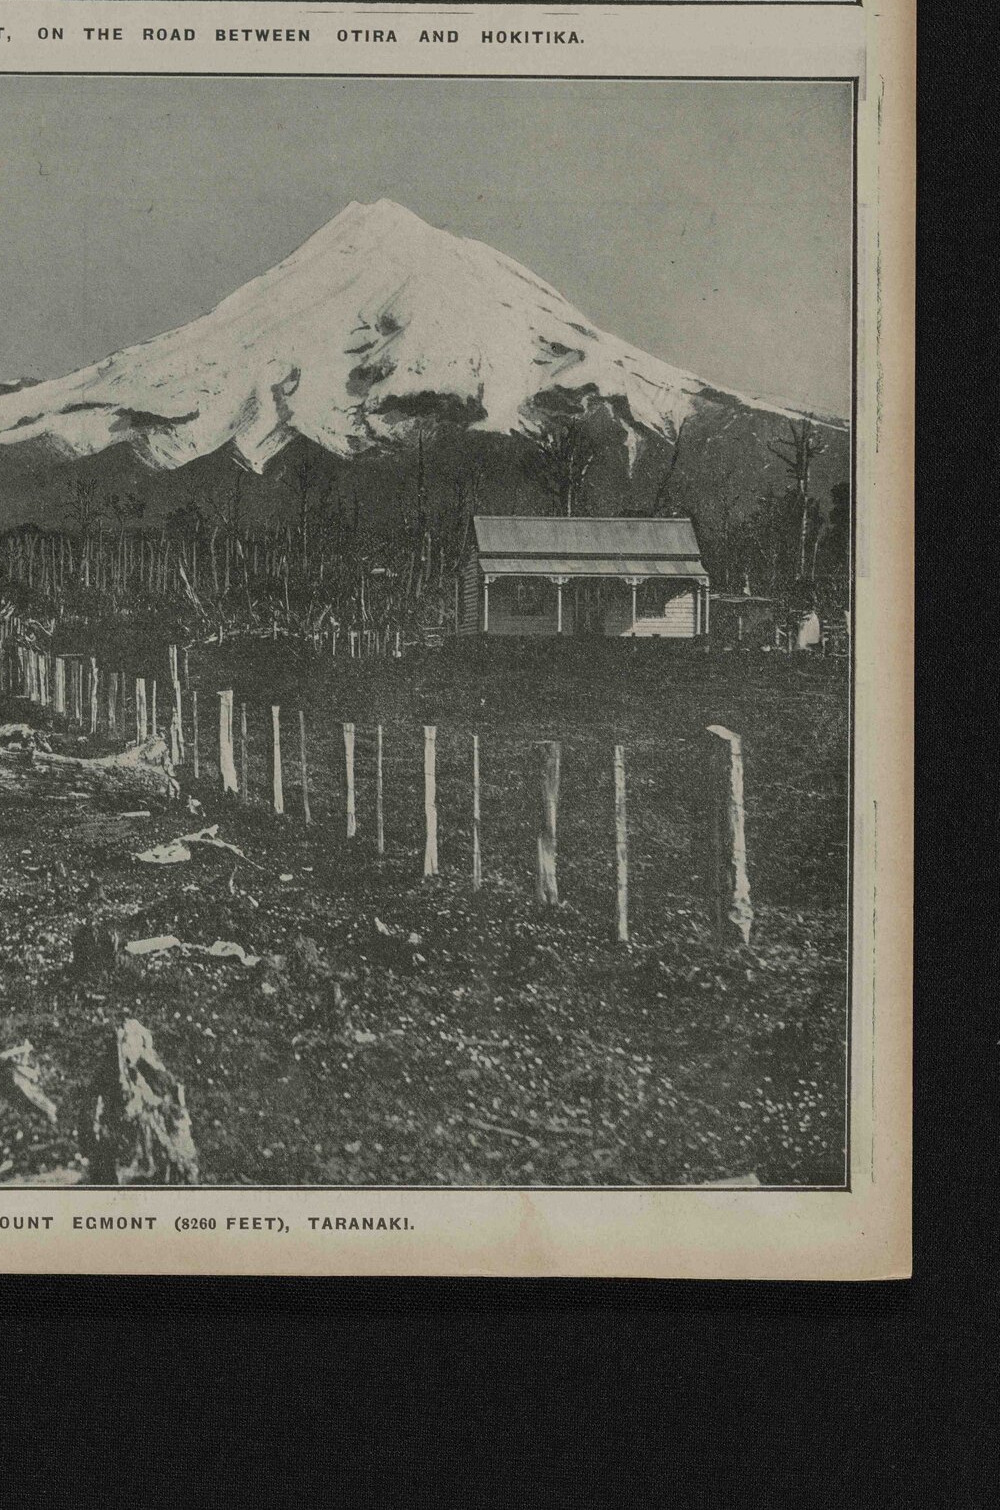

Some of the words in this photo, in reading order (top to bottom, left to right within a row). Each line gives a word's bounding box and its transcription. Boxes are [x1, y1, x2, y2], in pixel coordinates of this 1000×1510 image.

[37, 27, 64, 40] ON
[83, 27, 123, 41] THE
[143, 28, 196, 41] ROAD
[215, 29, 310, 42] BETWEEN
[337, 29, 397, 43] OTIRA
[419, 30, 459, 43] AND
[481, 30, 584, 44] HOKITIKA.
[72, 1216, 157, 1230] EGMONT
[174, 1216, 217, 1233] (8260
[226, 1217, 290, 1234] FEET),
[307, 1217, 415, 1231] TARANAKI.
